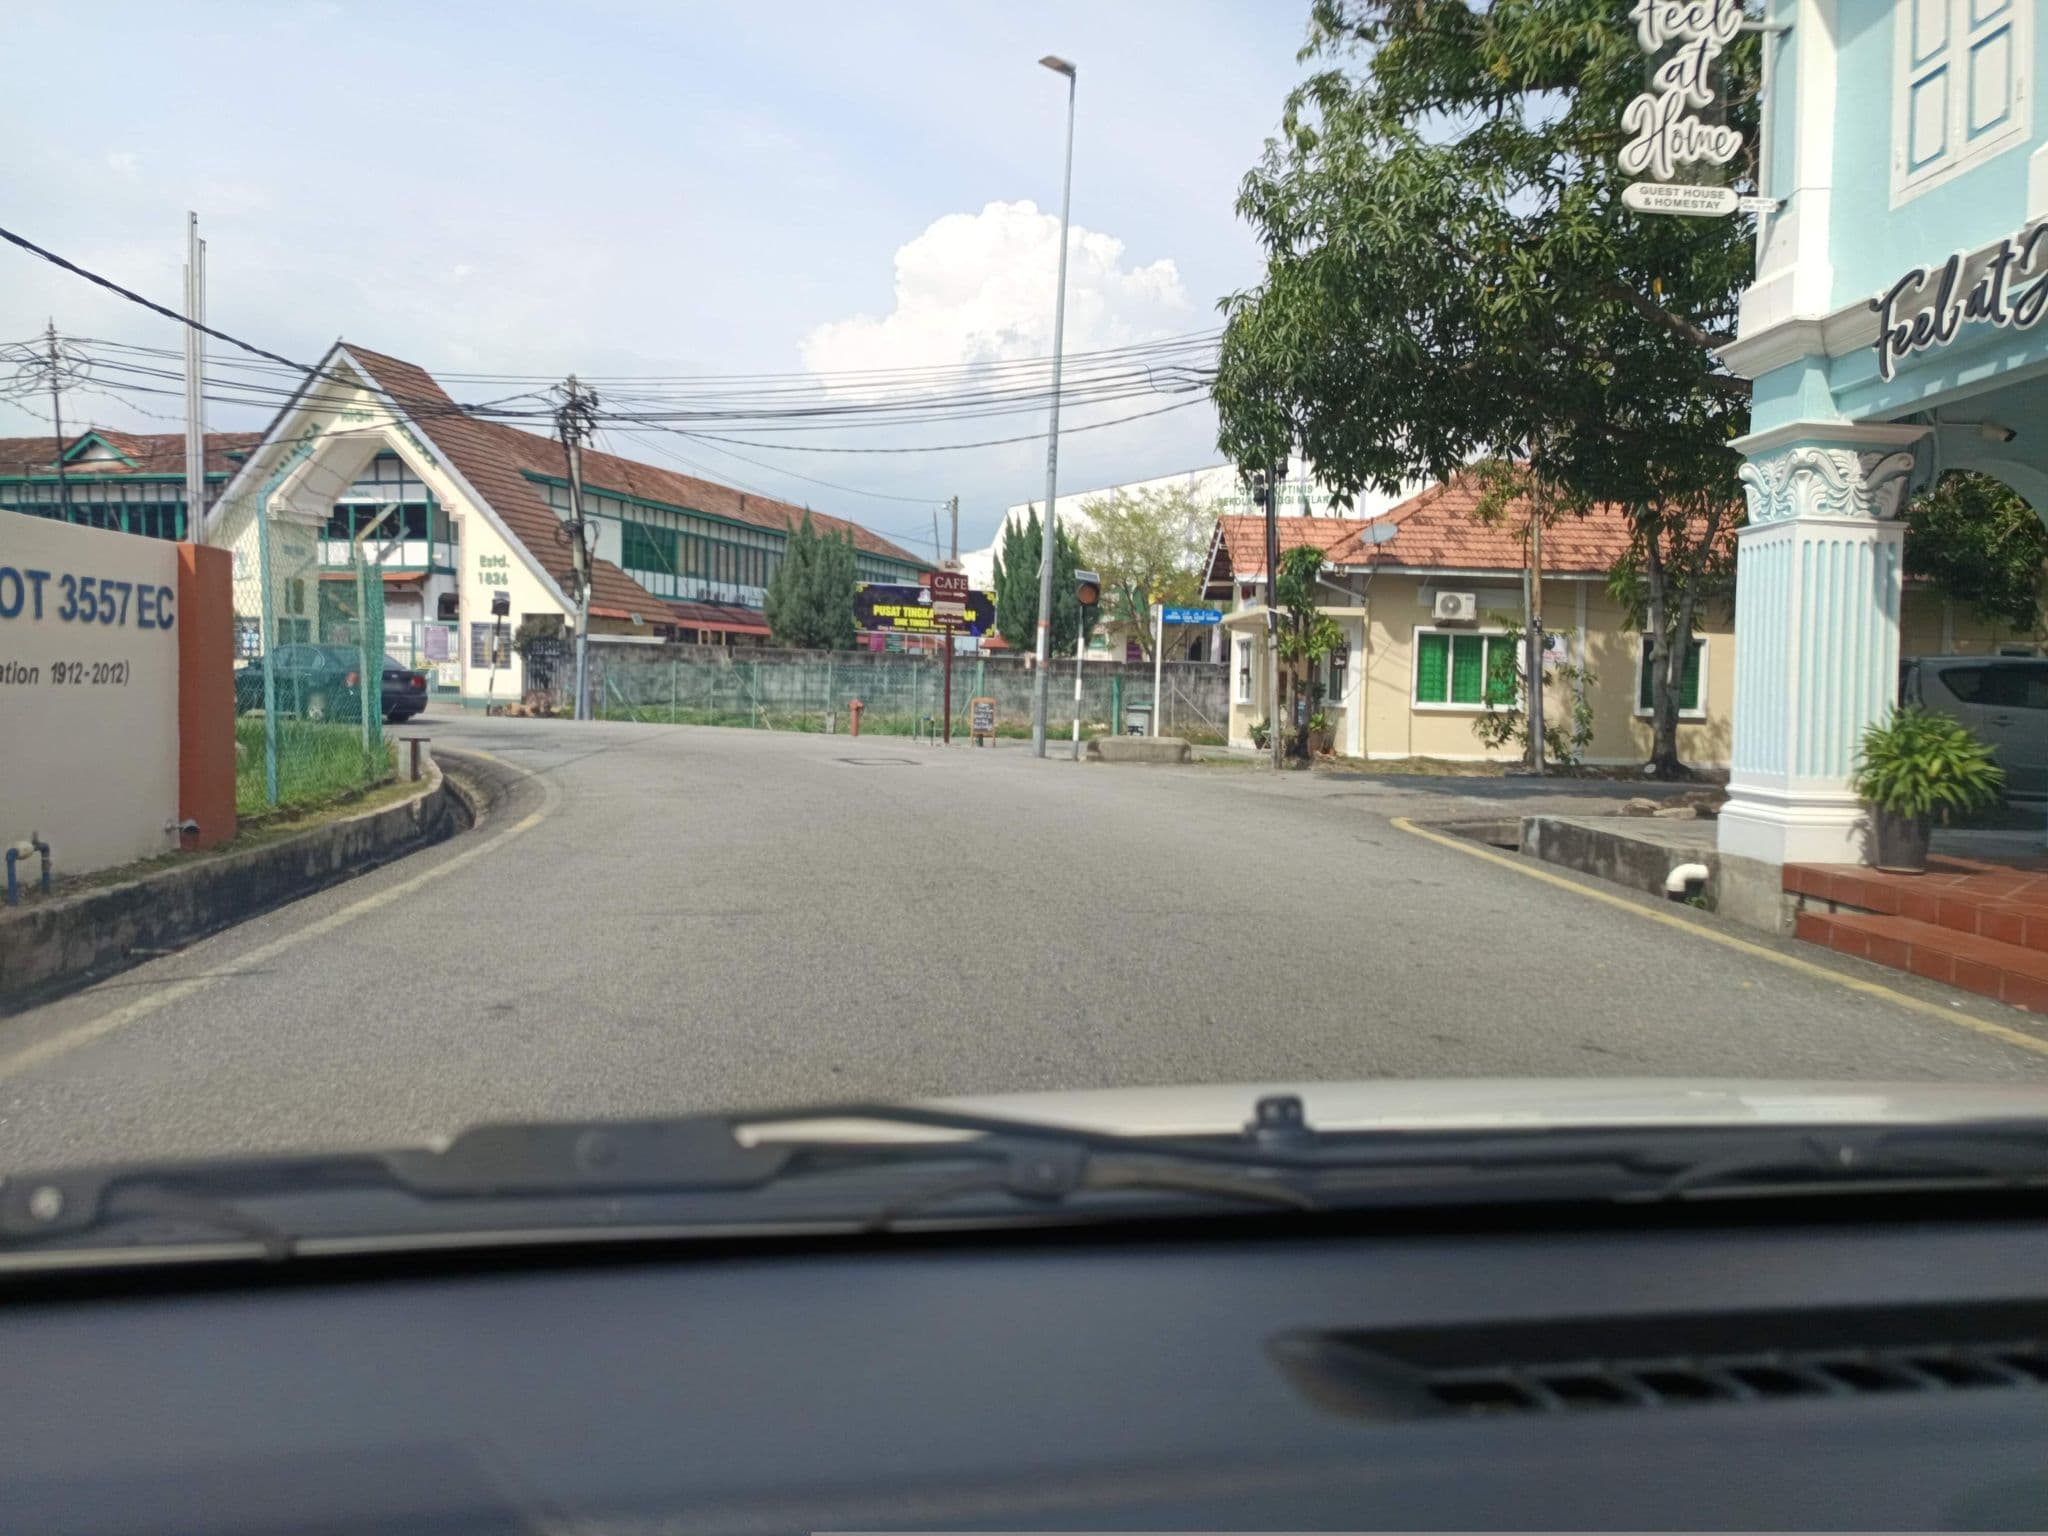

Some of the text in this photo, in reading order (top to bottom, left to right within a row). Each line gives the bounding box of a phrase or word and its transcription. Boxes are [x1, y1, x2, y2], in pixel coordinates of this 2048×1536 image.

[1655, 38, 1720, 105] at
[1619, 90, 1743, 179] Home
[1639, 185, 1726, 200] GUEST HOUSE
[1643, 197, 1721, 209] & HOMESTAY
[1869, 250, 1965, 382] Feel
[1964, 236, 2022, 326] at
[934, 576, 968, 590] CAFE
[58, 573, 133, 627] 3557
[136, 583, 175, 631] EC
[872, 604, 902, 618] PUSAT
[903, 605, 934, 619] TINGKA
